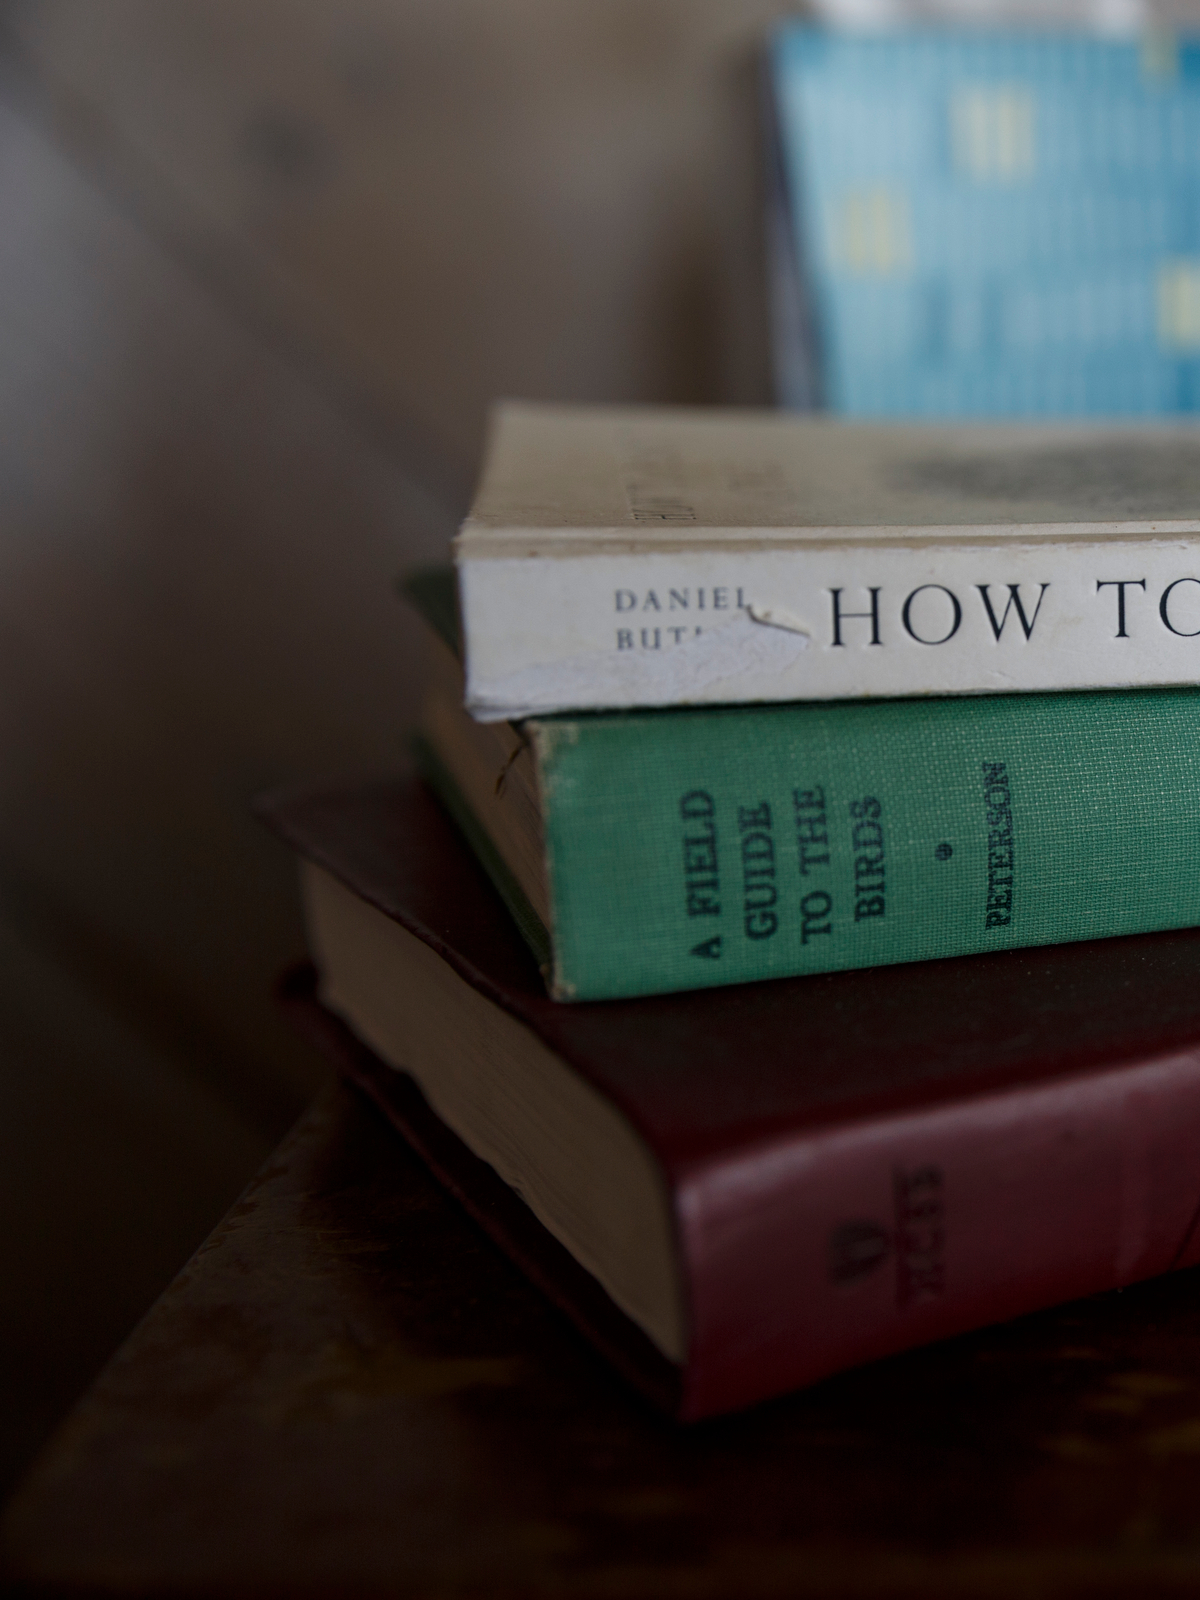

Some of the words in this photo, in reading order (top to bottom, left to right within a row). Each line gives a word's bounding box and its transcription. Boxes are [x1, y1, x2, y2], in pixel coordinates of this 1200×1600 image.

[614, 586, 746, 613] DANIEL
[828, 583, 1051, 646] HOW
[680, 789, 721, 918] FIELD
[738, 801, 779, 941] GUIDE
[793, 785, 831, 876] THE
[849, 795, 886, 922] BIRDS
[982, 761, 1014, 931] PETERSON
[688, 935, 721, 959] A
[801, 890, 832, 945] TO
